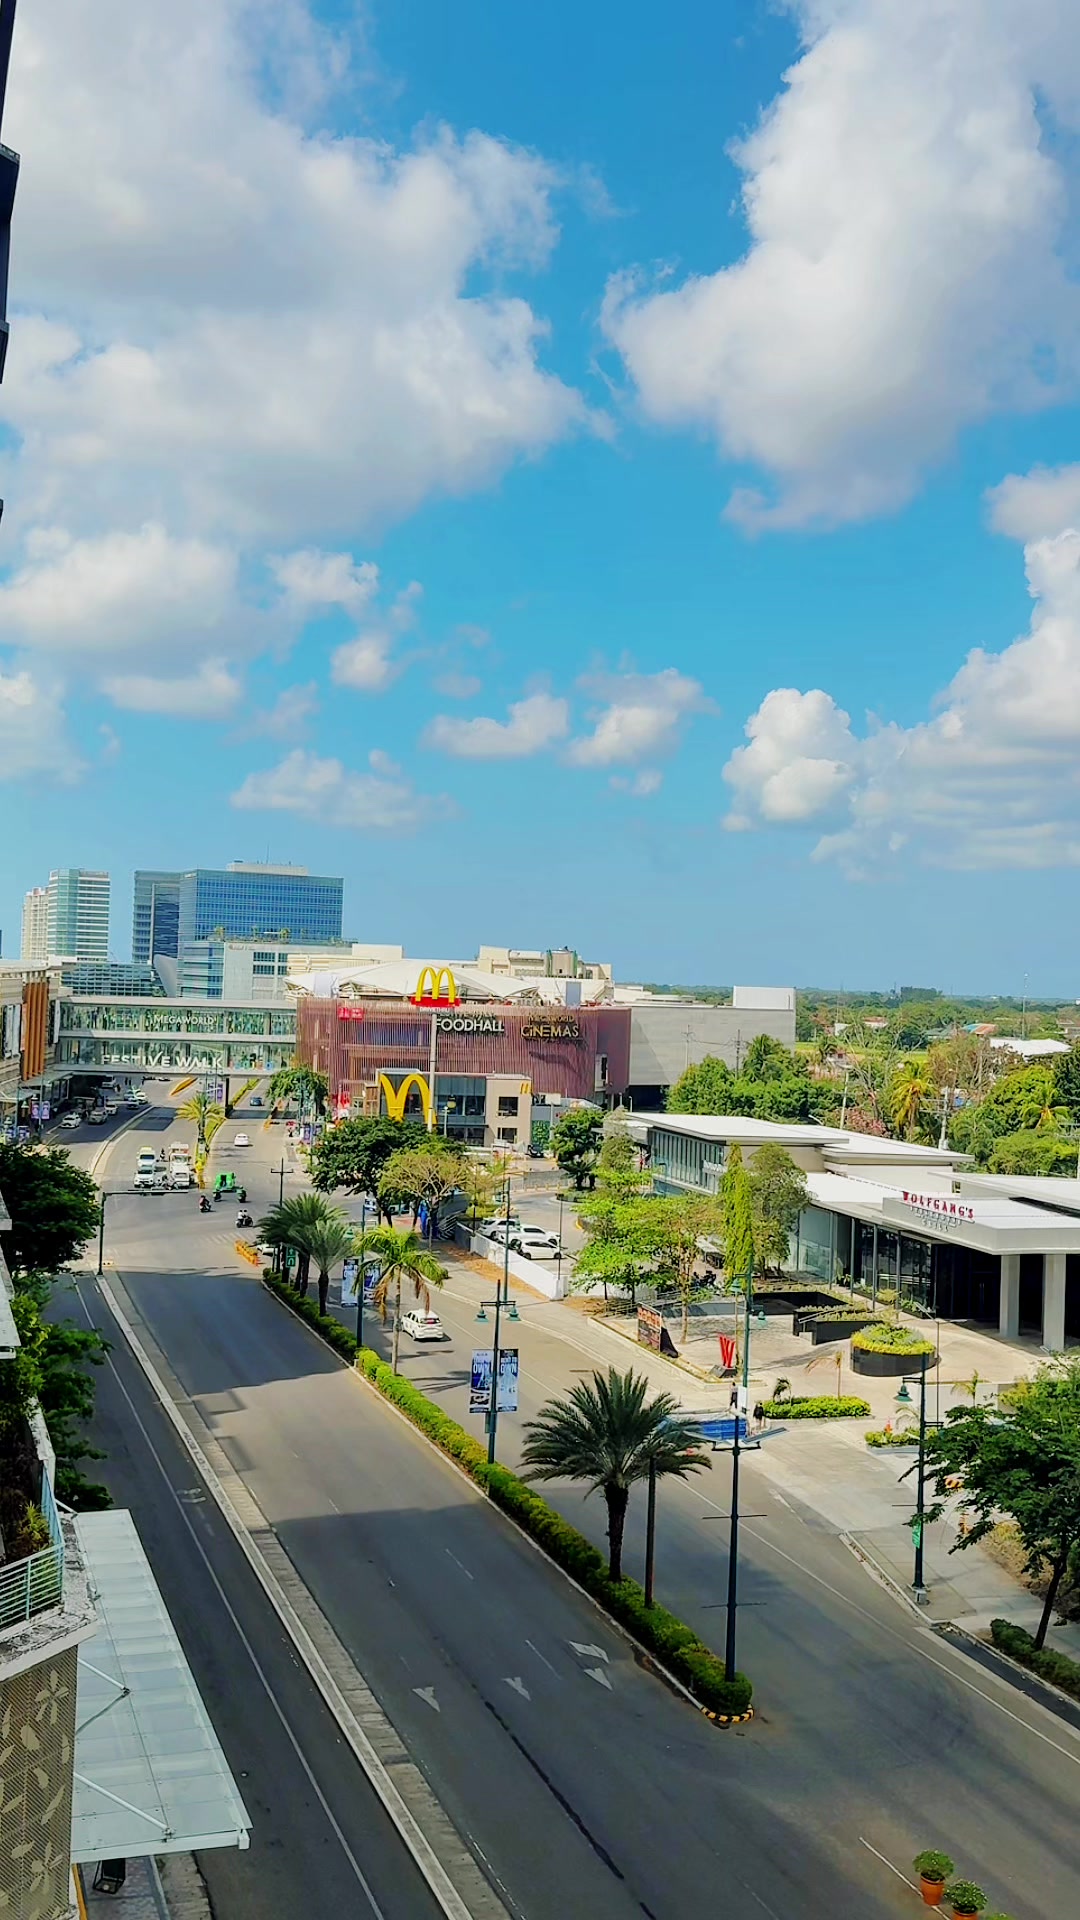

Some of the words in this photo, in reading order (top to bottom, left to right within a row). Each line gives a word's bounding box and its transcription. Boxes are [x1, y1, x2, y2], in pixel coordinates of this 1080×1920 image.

[153, 1015, 214, 1025] MEGAWORLD
[101, 1051, 171, 1068] FESTIVE
[176, 1055, 223, 1073] WALK
[903, 1190, 975, 1219] WOLFGANG'S
